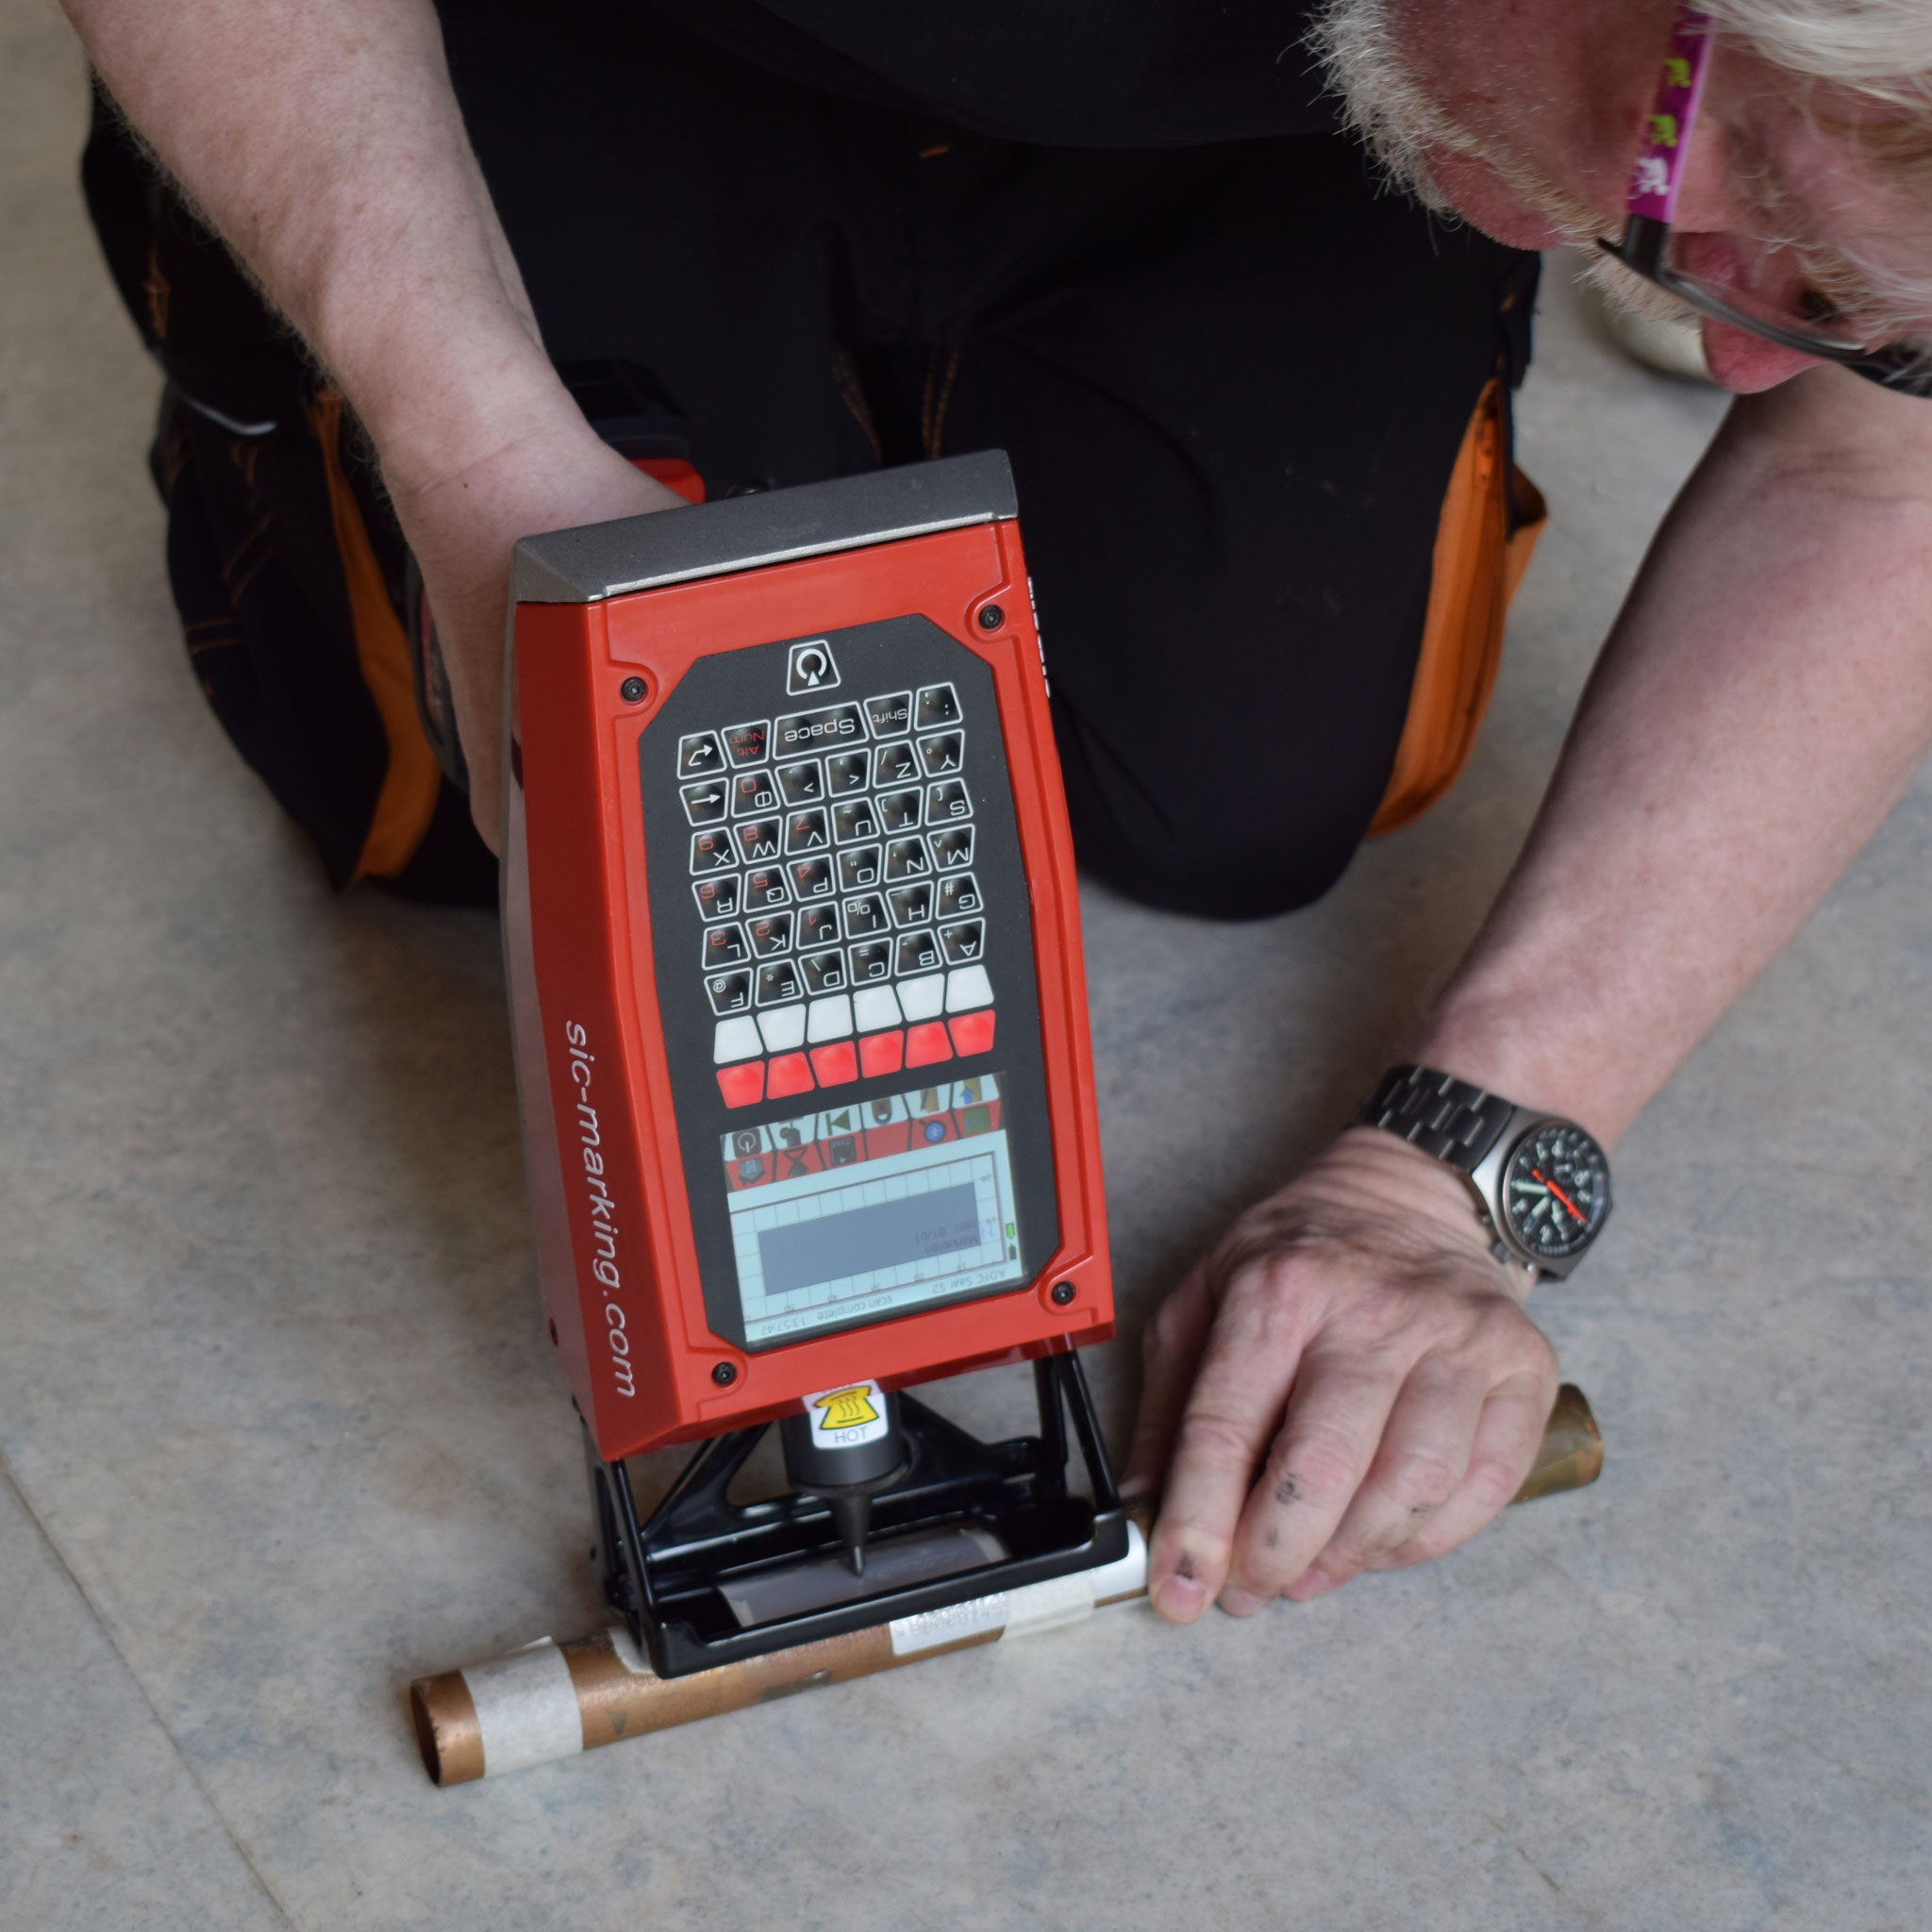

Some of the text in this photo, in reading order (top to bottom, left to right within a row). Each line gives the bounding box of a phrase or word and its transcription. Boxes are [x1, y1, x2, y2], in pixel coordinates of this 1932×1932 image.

[873, 708, 908, 724] Shift
[728, 731, 764, 745] Num
[785, 719, 855, 741] Space
[737, 745, 759, 757] Alt
[896, 761, 911, 778] Z
[941, 755, 956, 770] Y
[950, 800, 965, 815] S
[856, 820, 872, 836] U
[898, 812, 913, 827] T
[796, 817, 823, 846] V 7
[742, 826, 775, 858] W 8
[698, 836, 730, 866] X 9
[947, 847, 969, 864] M
[907, 857, 924, 874] N
[796, 865, 828, 892] P 4
[857, 868, 874, 884] O
[753, 874, 784, 903] Q 5
[944, 883, 975, 909] G #
[699, 885, 733, 913] R 6
[847, 902, 871, 915] %
[908, 904, 924, 921] H
[808, 912, 832, 940] J 1
[710, 931, 741, 958] L 3
[755, 921, 786, 951] K 2
[960, 941, 975, 956] A
[919, 950, 934, 966] B
[868, 962, 884, 977] C
[824, 971, 840, 987] D
[712, 979, 743, 1008] F @
[781, 981, 794, 996] E
[566, 1020, 635, 1397] sic-marking.com
[950, 1275, 972, 1289] Saar
[975, 1271, 1006, 1283] ADFC
[816, 1295, 892, 1321] scan complete
[761, 1318, 806, 1336] 13:57:47
[834, 1425, 868, 1443] HOT
